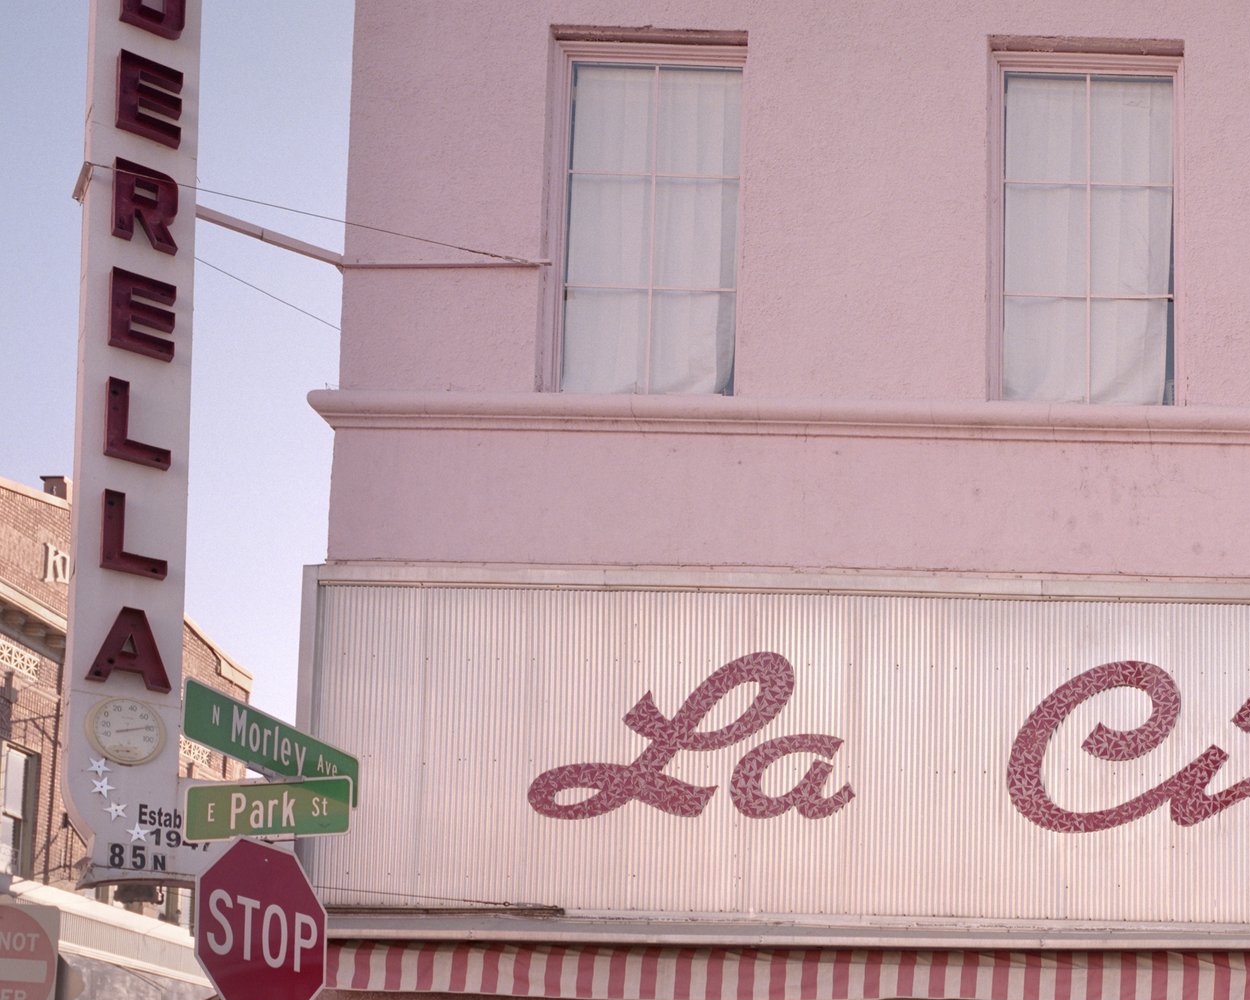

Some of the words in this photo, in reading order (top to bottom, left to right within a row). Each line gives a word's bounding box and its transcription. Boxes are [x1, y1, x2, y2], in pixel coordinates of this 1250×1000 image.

[212, 704, 220, 727] N
[231, 704, 306, 777] Morley
[316, 754, 338, 778] Ave
[527, 651, 856, 820] La
[138, 803, 183, 829] Estab
[207, 803, 216, 822] E
[229, 791, 297, 831] Park
[311, 797, 329, 817] St
[149, 828, 211, 852] 19
[206, 888, 318, 974] STOP
